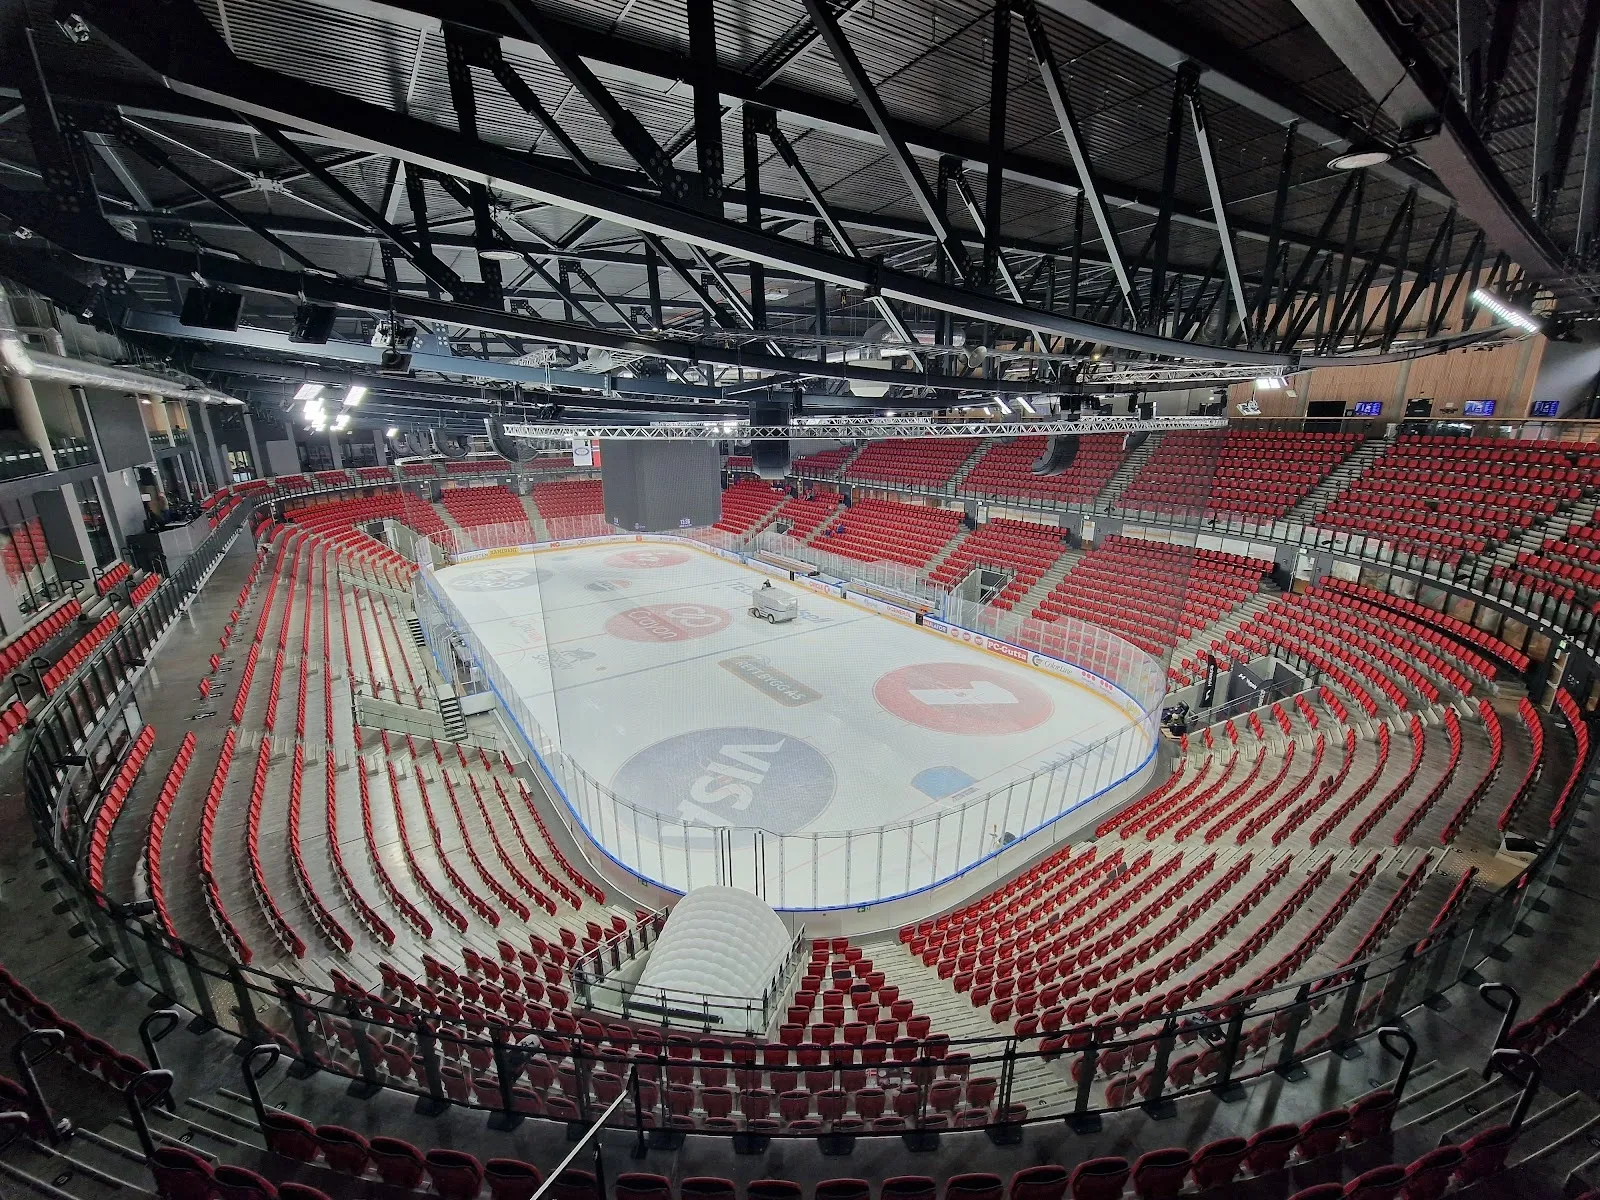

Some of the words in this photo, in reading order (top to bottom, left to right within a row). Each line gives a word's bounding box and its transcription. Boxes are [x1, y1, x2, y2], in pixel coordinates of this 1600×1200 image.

[628, 610, 677, 640] Crayon
[987, 640, 1027, 661] PC-Gutta
[661, 738, 786, 838] VISA
